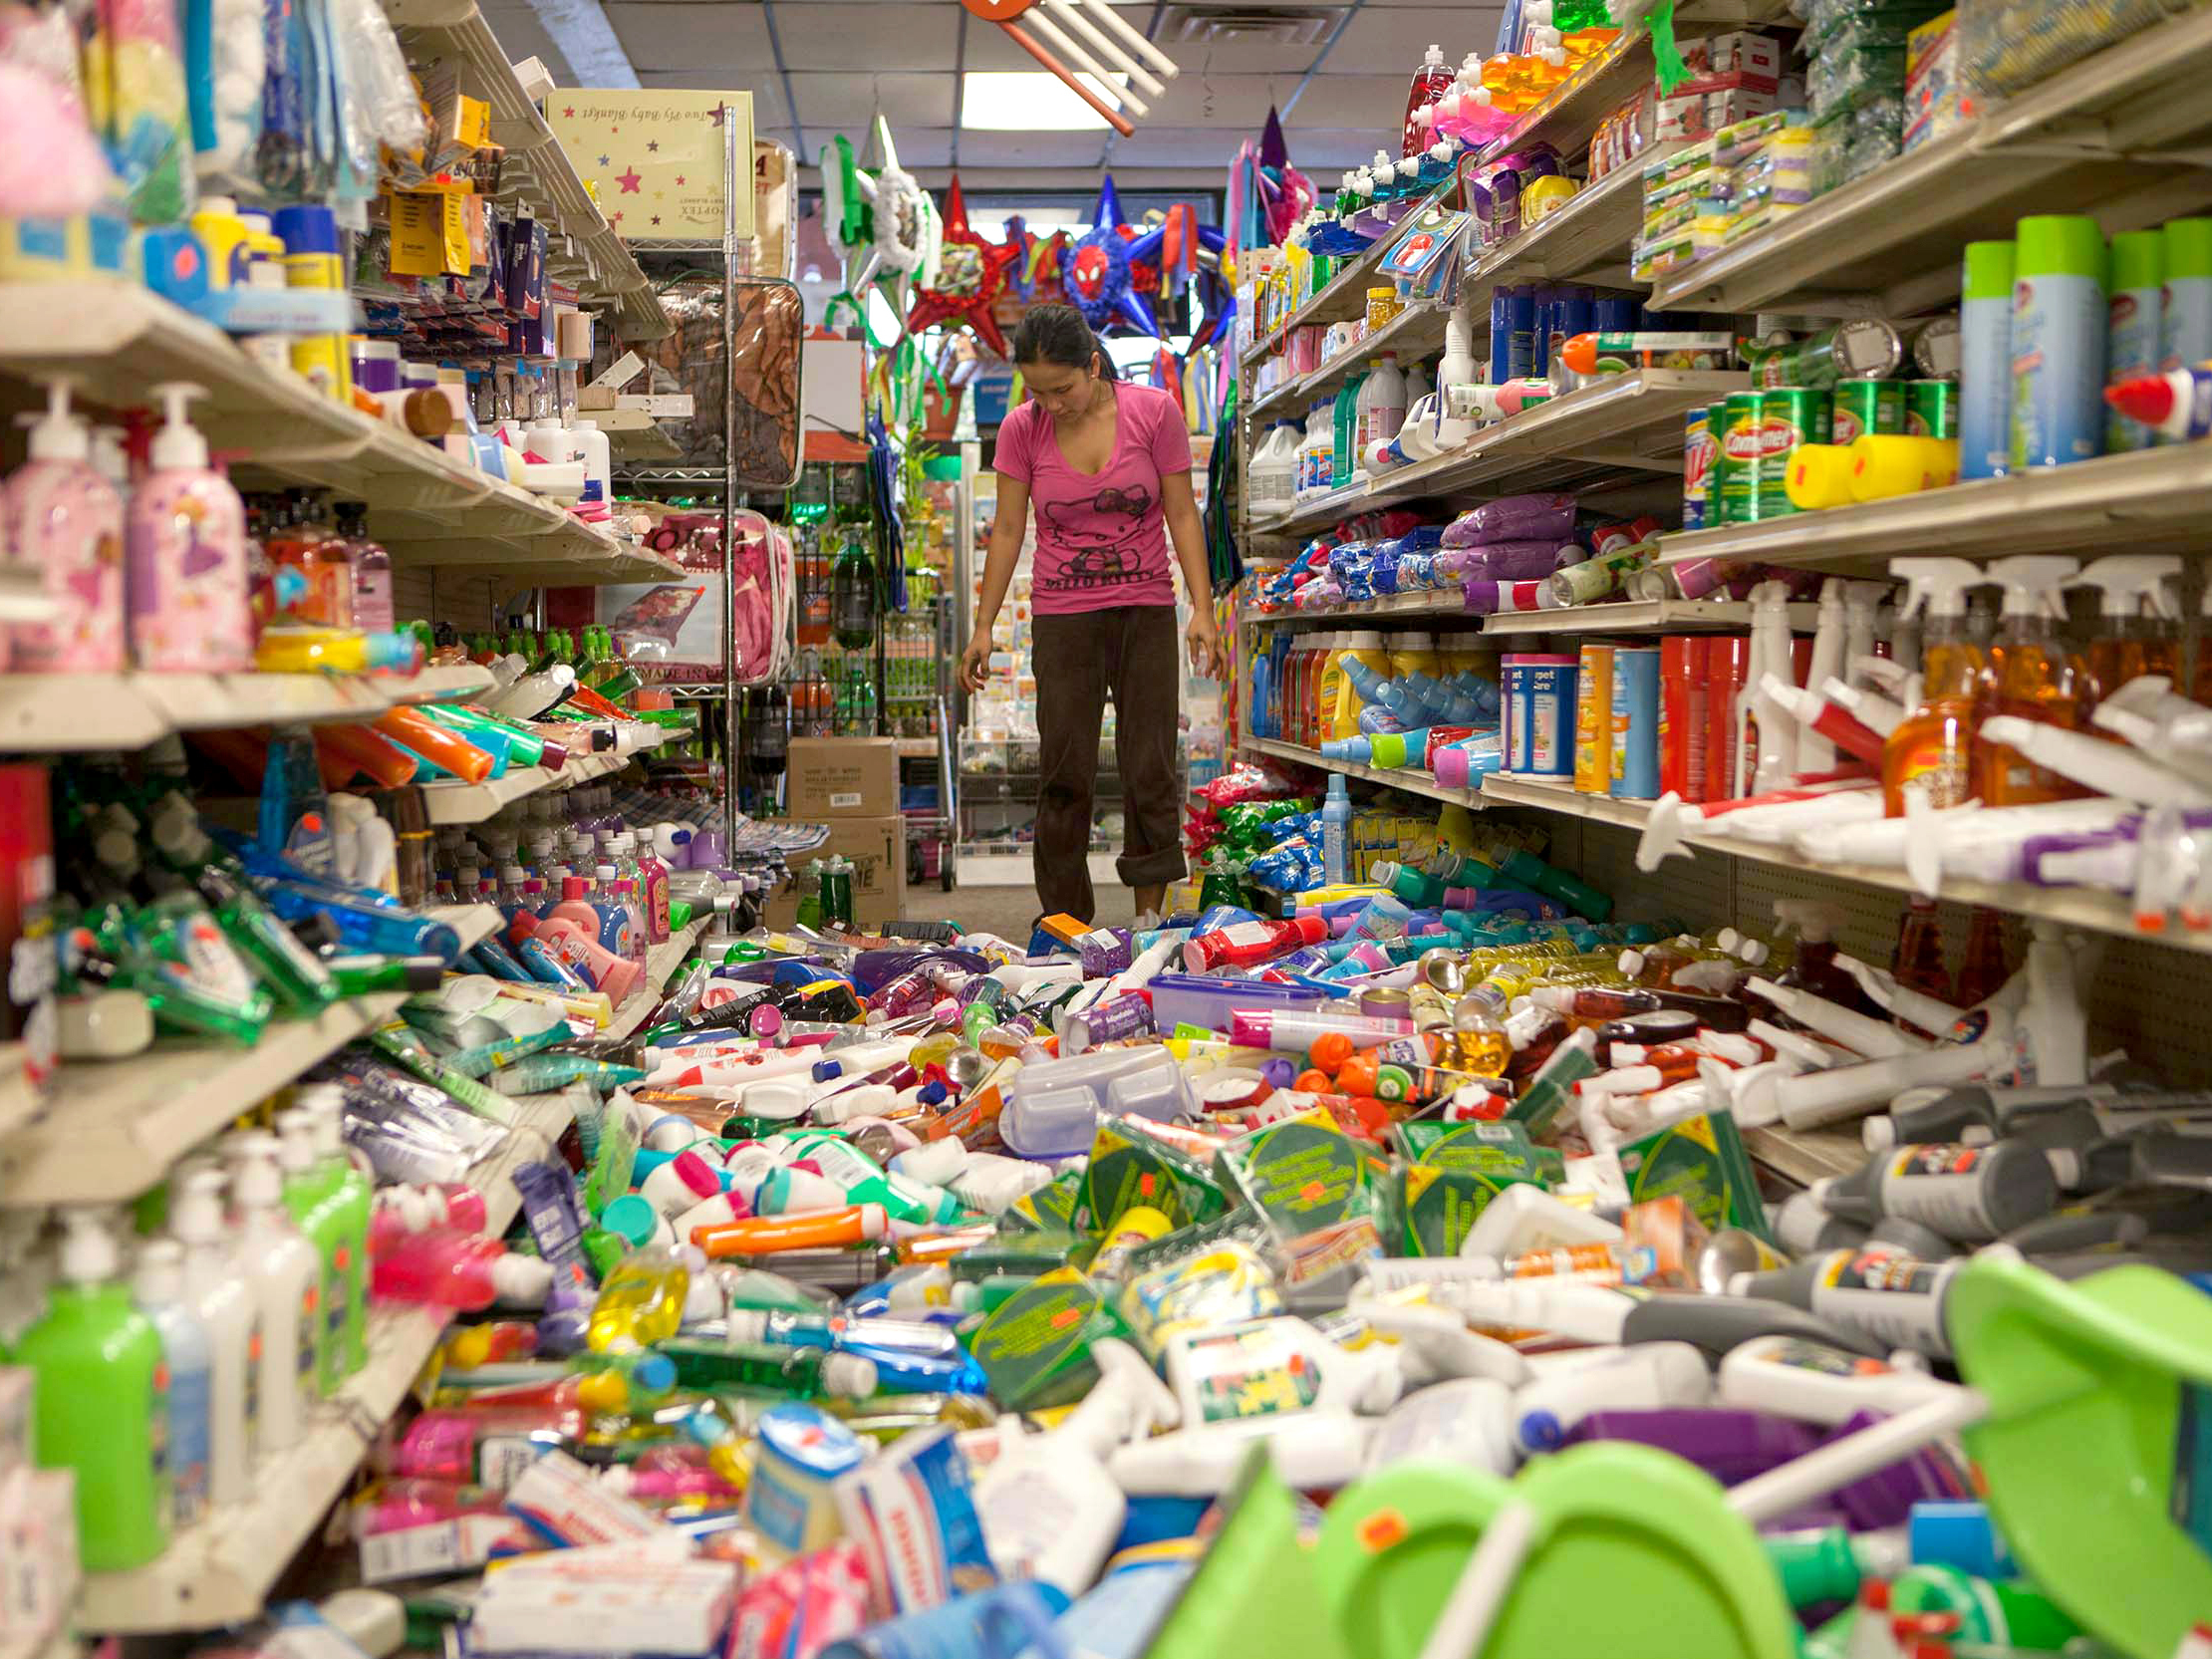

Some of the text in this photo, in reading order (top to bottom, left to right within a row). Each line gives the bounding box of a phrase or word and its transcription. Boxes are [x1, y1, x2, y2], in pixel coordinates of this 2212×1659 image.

[582, 107, 707, 122] Two Ply Baby Blanket
[682, 206, 723, 216] OPTEX
[641, 667, 751, 680] MADE IN CHNA
